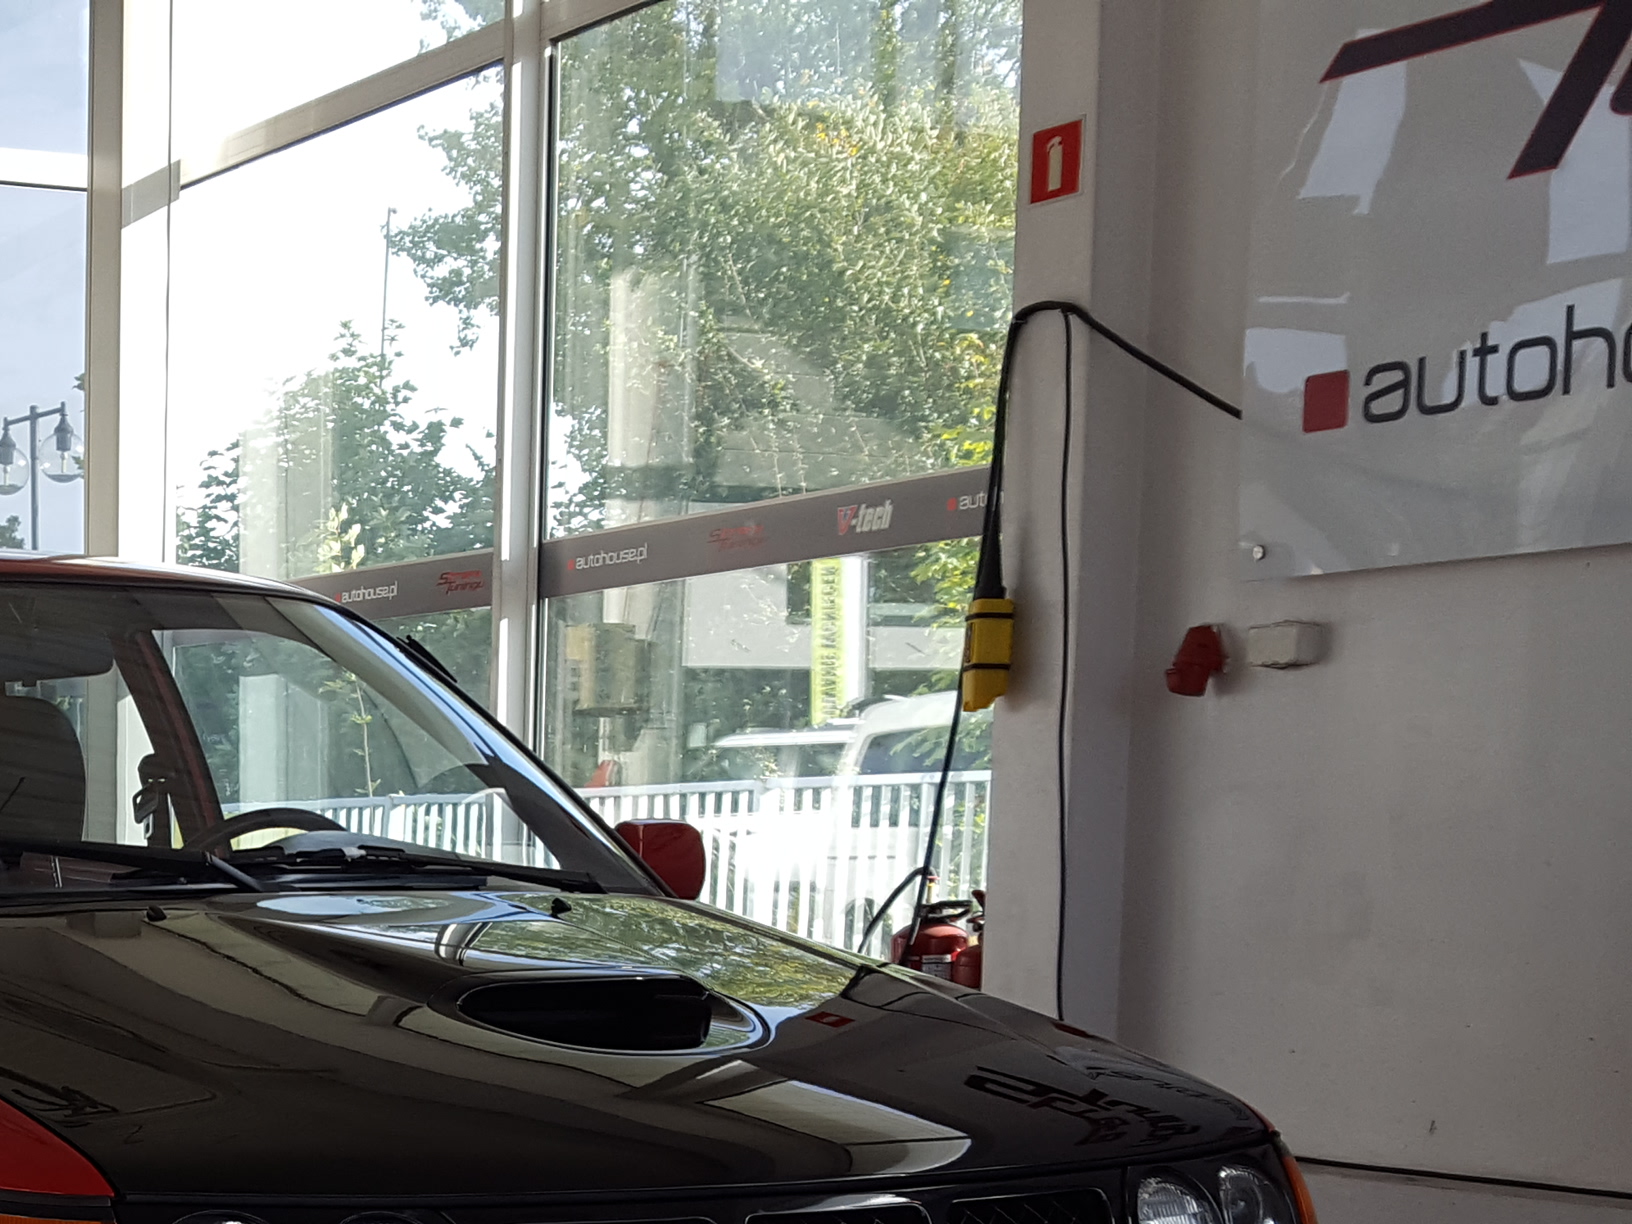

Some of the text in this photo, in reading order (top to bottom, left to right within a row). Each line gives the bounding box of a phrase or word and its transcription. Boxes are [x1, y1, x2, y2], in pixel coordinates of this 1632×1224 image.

[1363, 304, 1632, 424] autoh
[837, 499, 894, 536] V-tech
[575, 543, 648, 570] autohouse.pl
[341, 581, 398, 603] autohouse.pl
